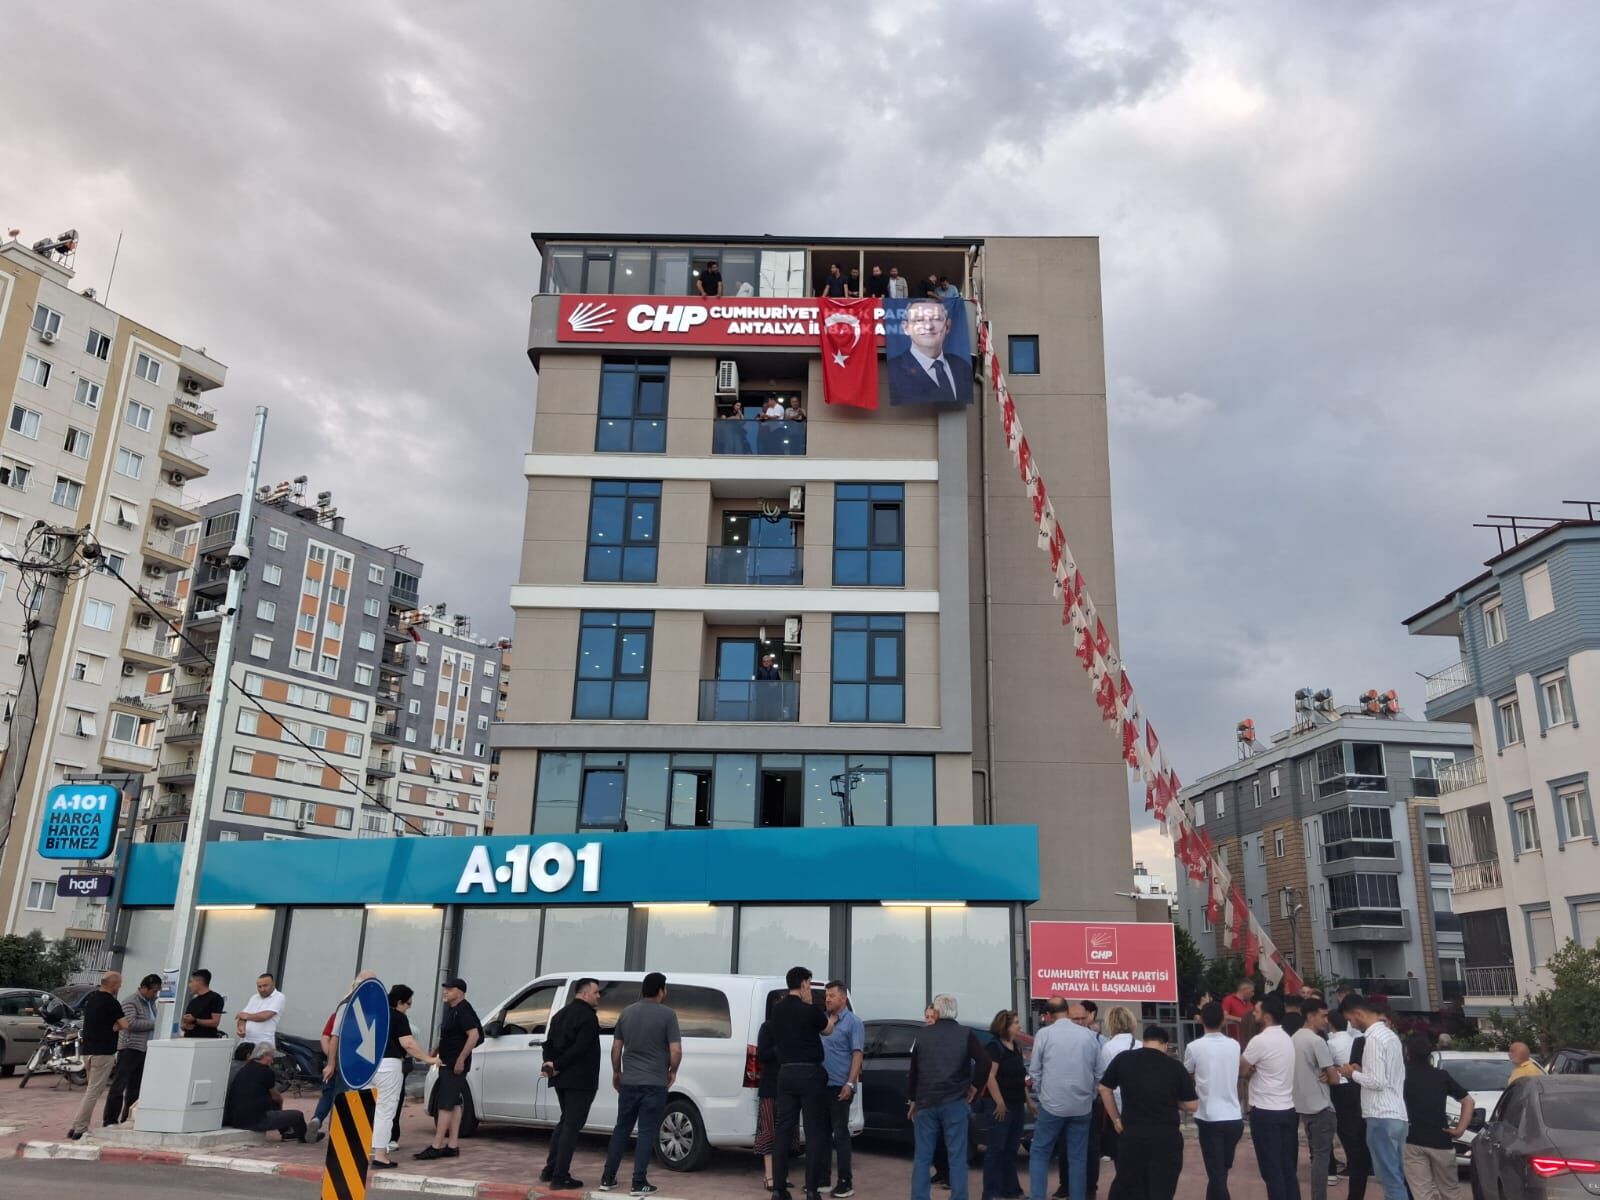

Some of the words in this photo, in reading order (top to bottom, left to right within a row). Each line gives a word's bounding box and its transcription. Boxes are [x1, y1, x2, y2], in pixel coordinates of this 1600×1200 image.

[627, 304, 707, 332] CHP
[709, 304, 819, 319] CUMHURİYET
[727, 322, 805, 335] ANTALYA
[50, 812, 101, 824] HARCA
[48, 825, 99, 836] HARCA
[69, 877, 99, 891] hadi
[1090, 950, 1113, 960] CHP
[1037, 967, 1100, 979] CUMHURİYET
[1103, 970, 1129, 980] HALK
[1132, 969, 1169, 981] PARTİSİ
[1051, 982, 1089, 992] ANTALYA
[1091, 981, 1100, 992] İL
[1102, 982, 1156, 994] BAŞKANLIĞI
